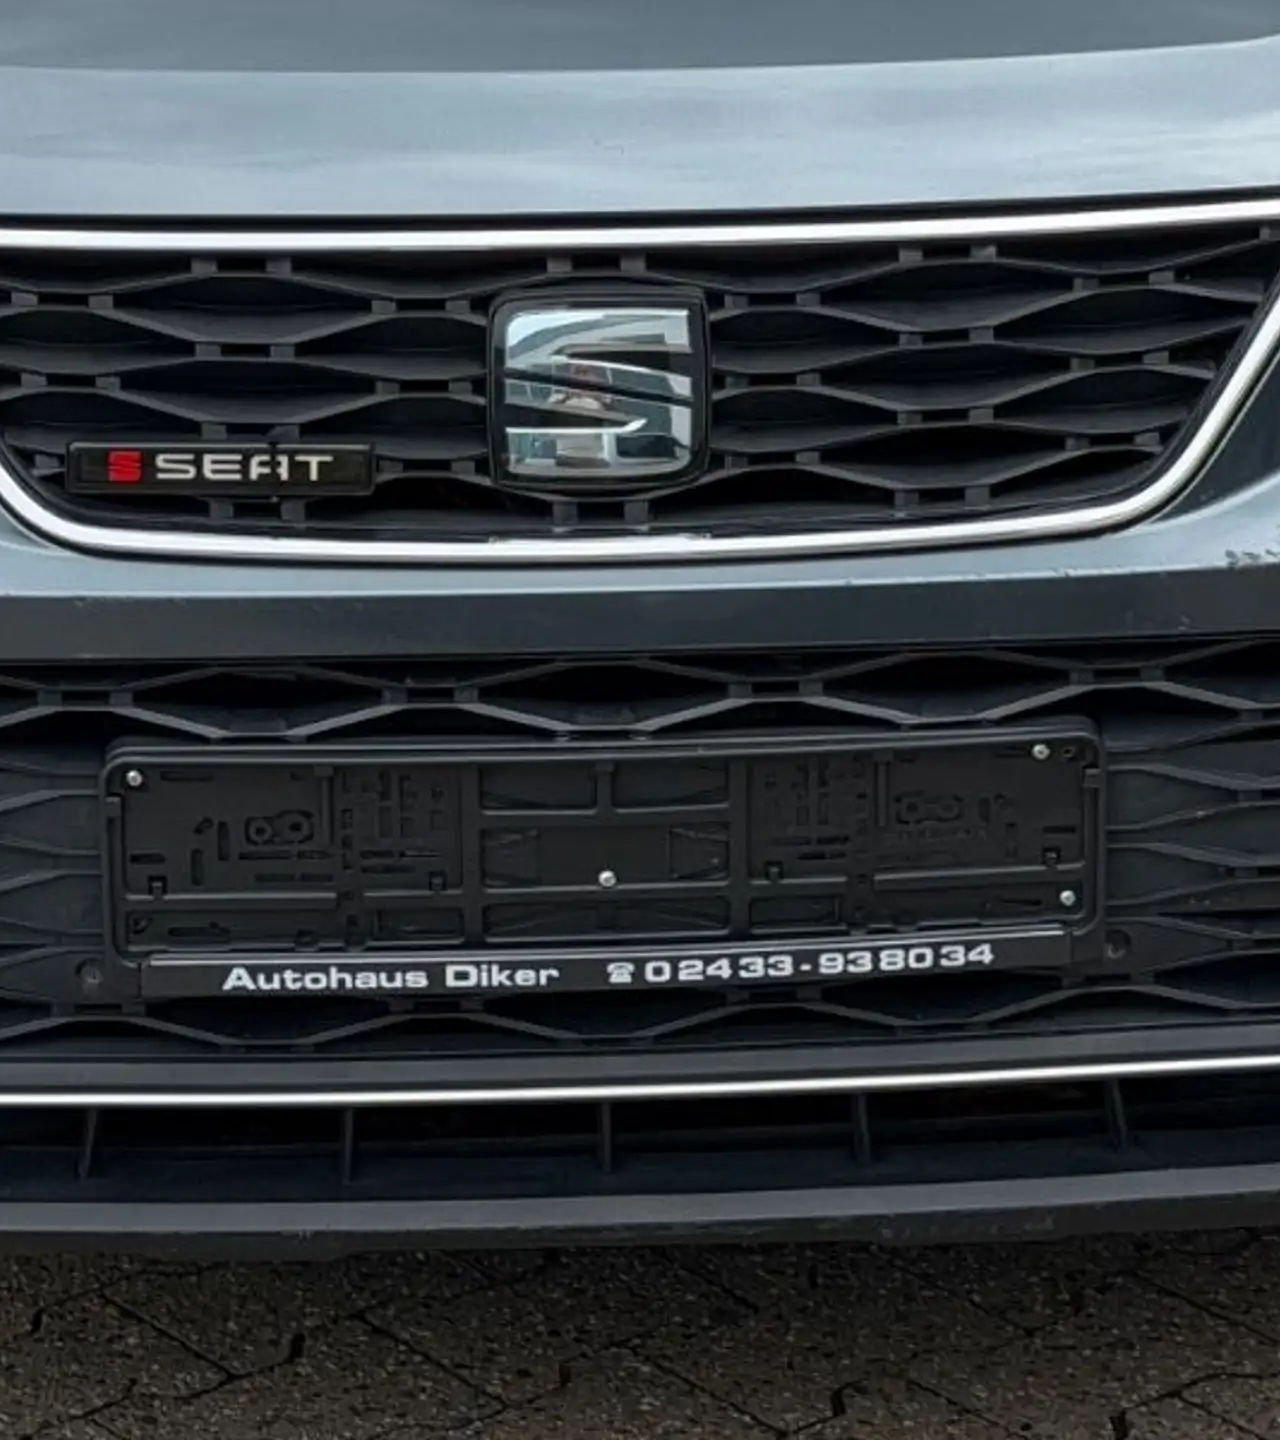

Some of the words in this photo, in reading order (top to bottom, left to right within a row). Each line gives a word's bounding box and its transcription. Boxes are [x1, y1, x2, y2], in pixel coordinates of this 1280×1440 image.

[155, 453, 333, 481] SEAT
[222, 966, 428, 991] Autohaus
[445, 963, 560, 988] Diker
